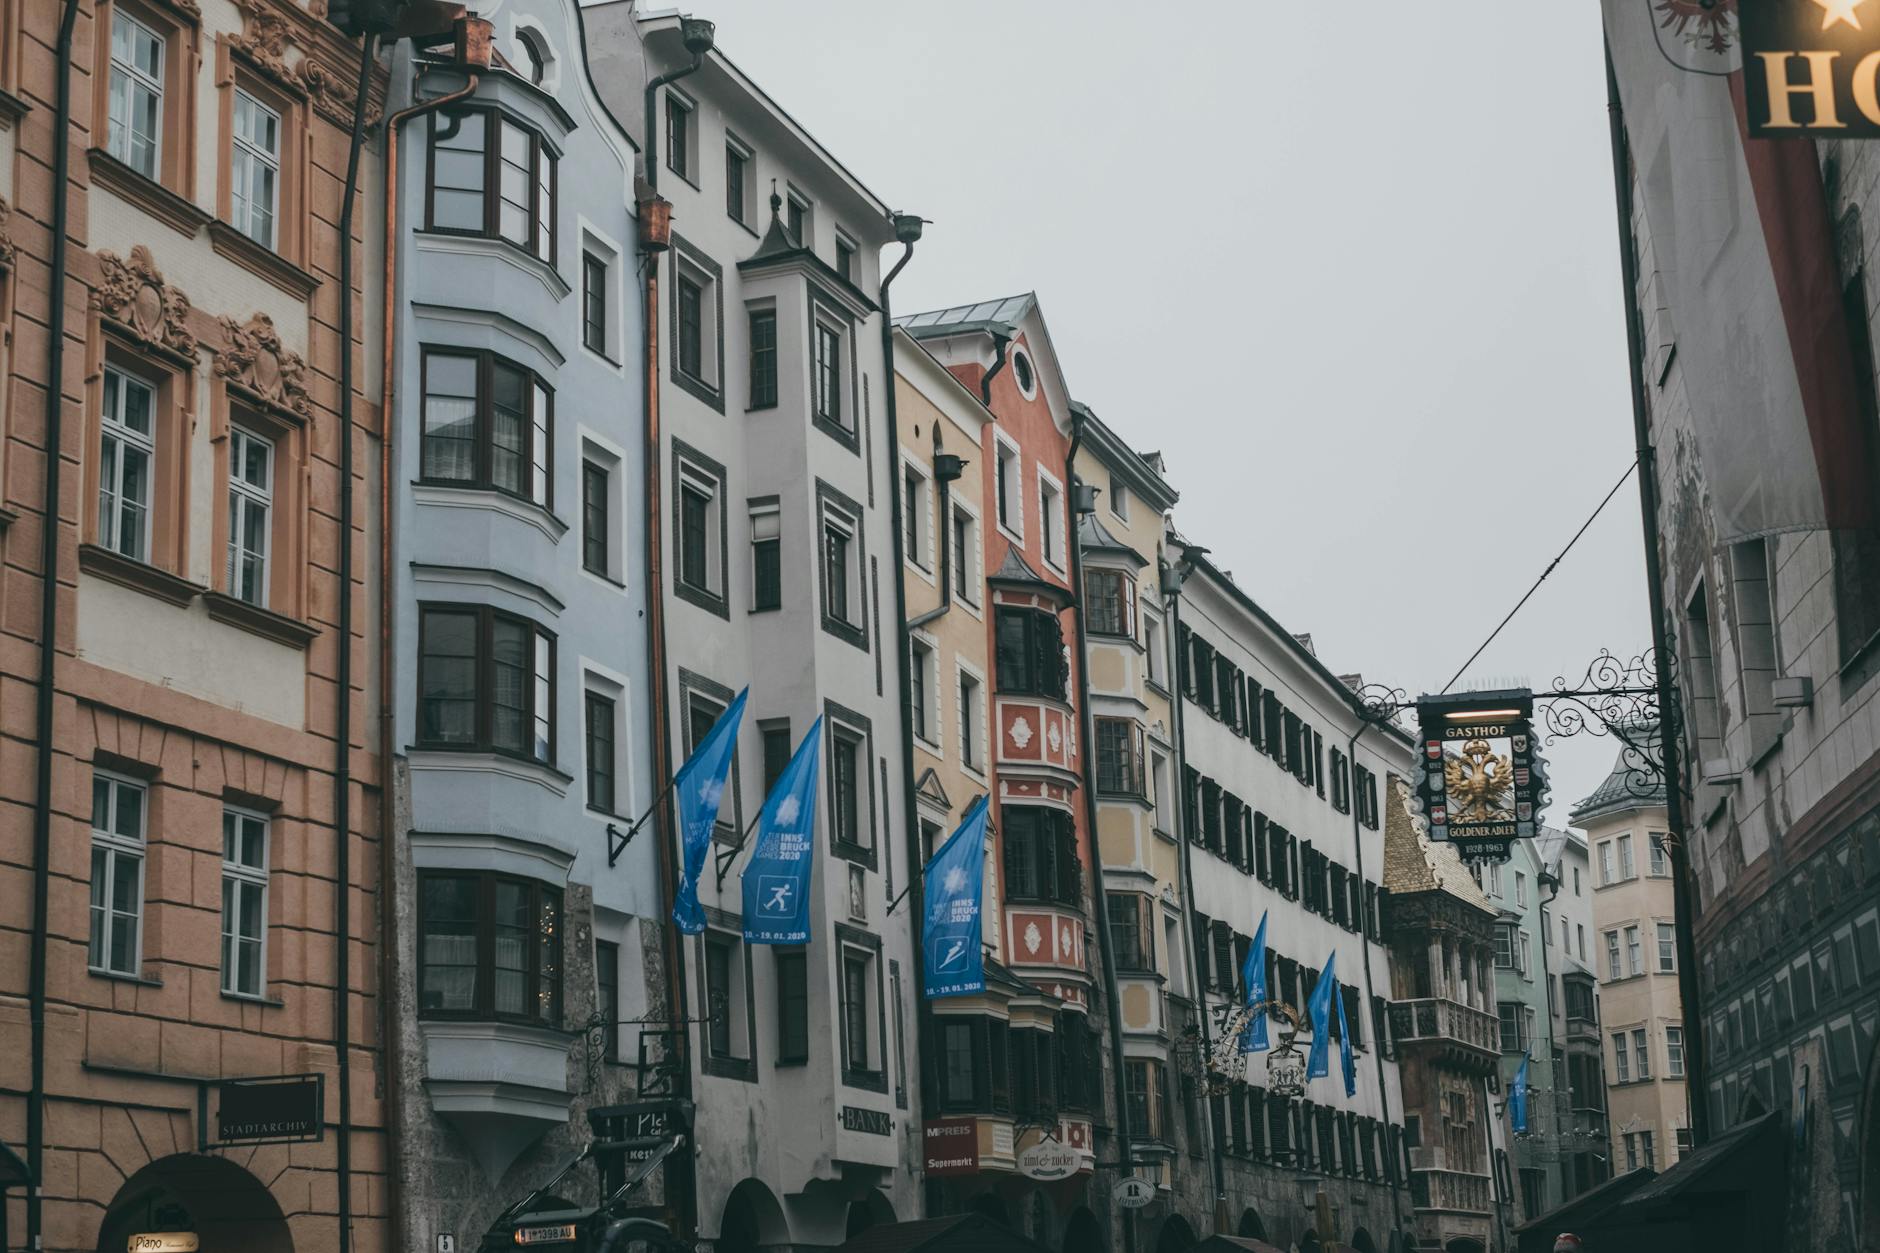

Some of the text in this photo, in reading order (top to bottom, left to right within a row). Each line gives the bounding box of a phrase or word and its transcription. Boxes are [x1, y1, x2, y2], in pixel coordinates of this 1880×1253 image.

[1445, 726, 1506, 737] GASTHOF
[1449, 827, 1490, 837] GOLDENER
[1491, 825, 1516, 836] ADLER
[779, 842, 811, 852] BRUCK
[779, 851, 801, 861] 2020
[951, 906, 979, 916] BRUCK
[951, 914, 971, 923] 2020
[846, 1108, 889, 1134] BANK
[223, 1120, 308, 1136] STADTARCHIV
[927, 1125, 971, 1137] MPREIS
[928, 1157, 973, 1168] Supermarkt
[1051, 1153, 1074, 1167] zucker
[135, 1236, 162, 1250] Piano
